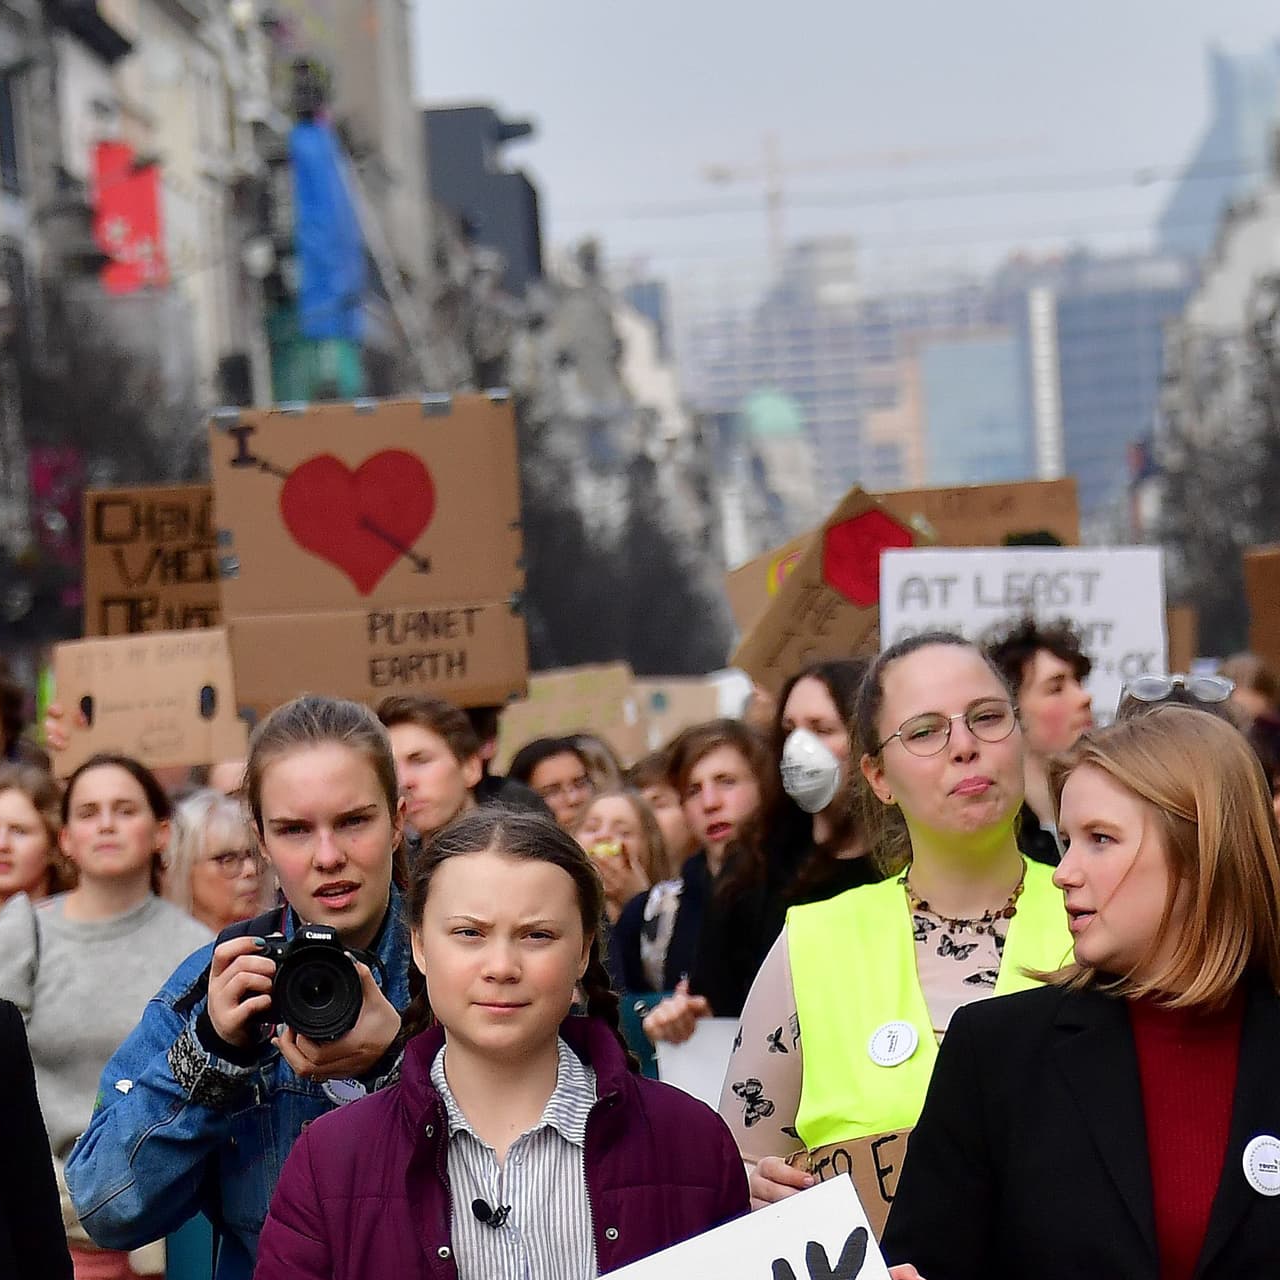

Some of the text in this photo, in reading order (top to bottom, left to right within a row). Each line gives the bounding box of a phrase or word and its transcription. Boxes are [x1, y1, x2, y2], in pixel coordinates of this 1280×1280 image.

[898, 569, 1102, 609] AT LEAST
[367, 606, 483, 644] PLANET
[368, 649, 469, 687] EARTH
[305, 931, 332, 940] Canon
